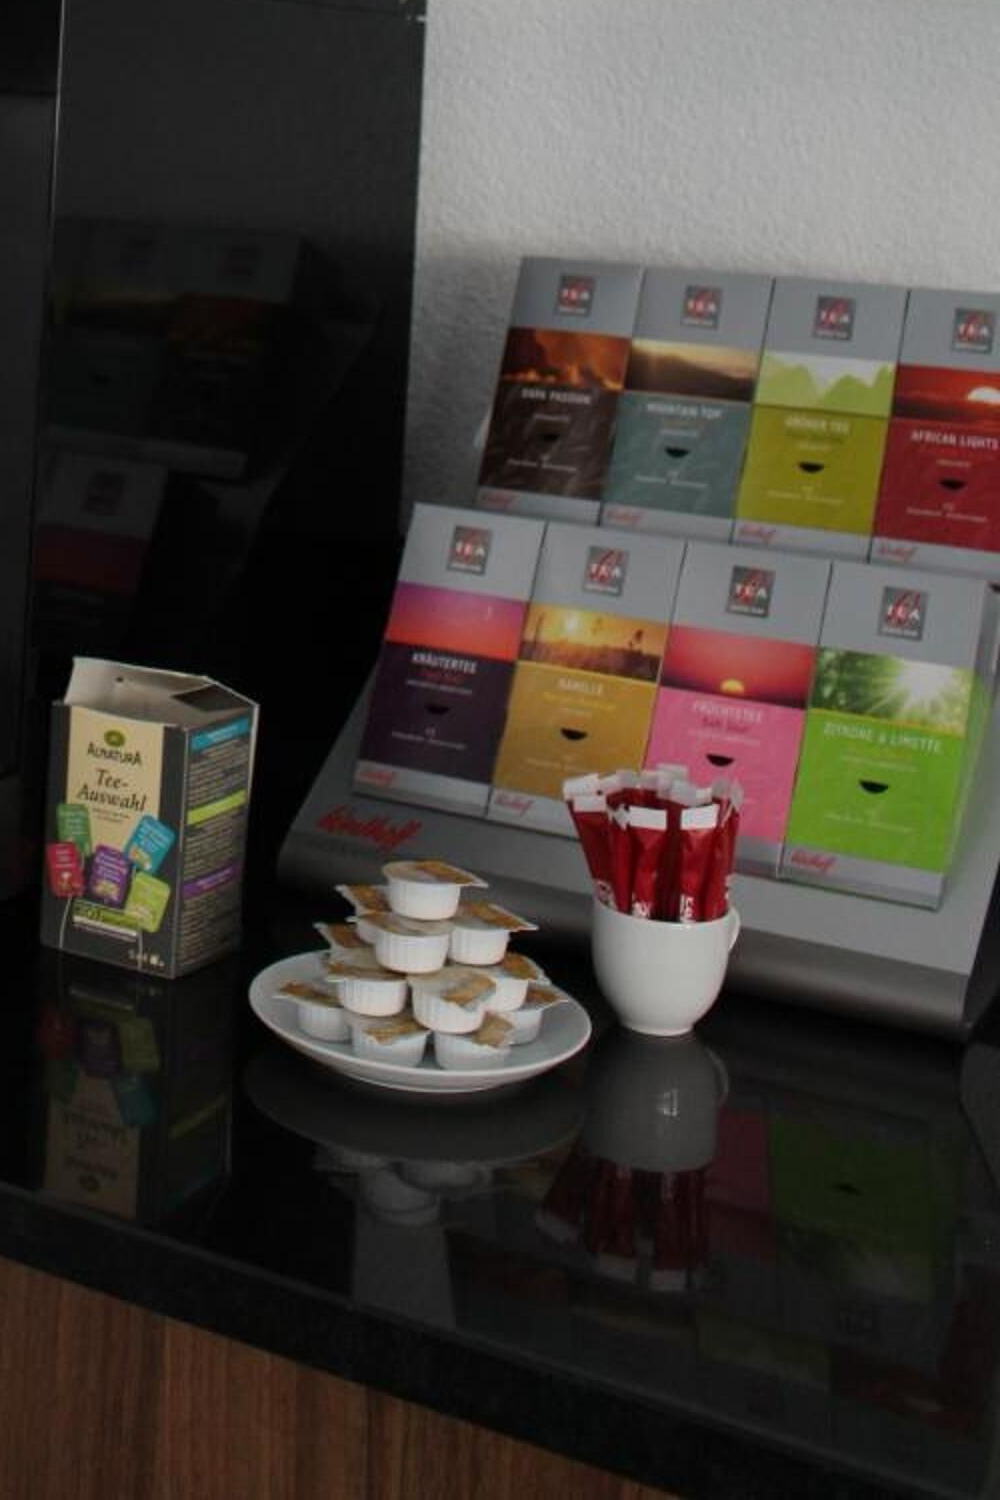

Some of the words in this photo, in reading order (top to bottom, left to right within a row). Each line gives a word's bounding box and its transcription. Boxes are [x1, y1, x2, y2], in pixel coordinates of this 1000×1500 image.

[910, 429, 957, 446] AFRICAN
[959, 433, 1000, 450] LIGHTS
[96, 767, 129, 790] Tee-
[77, 783, 148, 812] Auswahl
